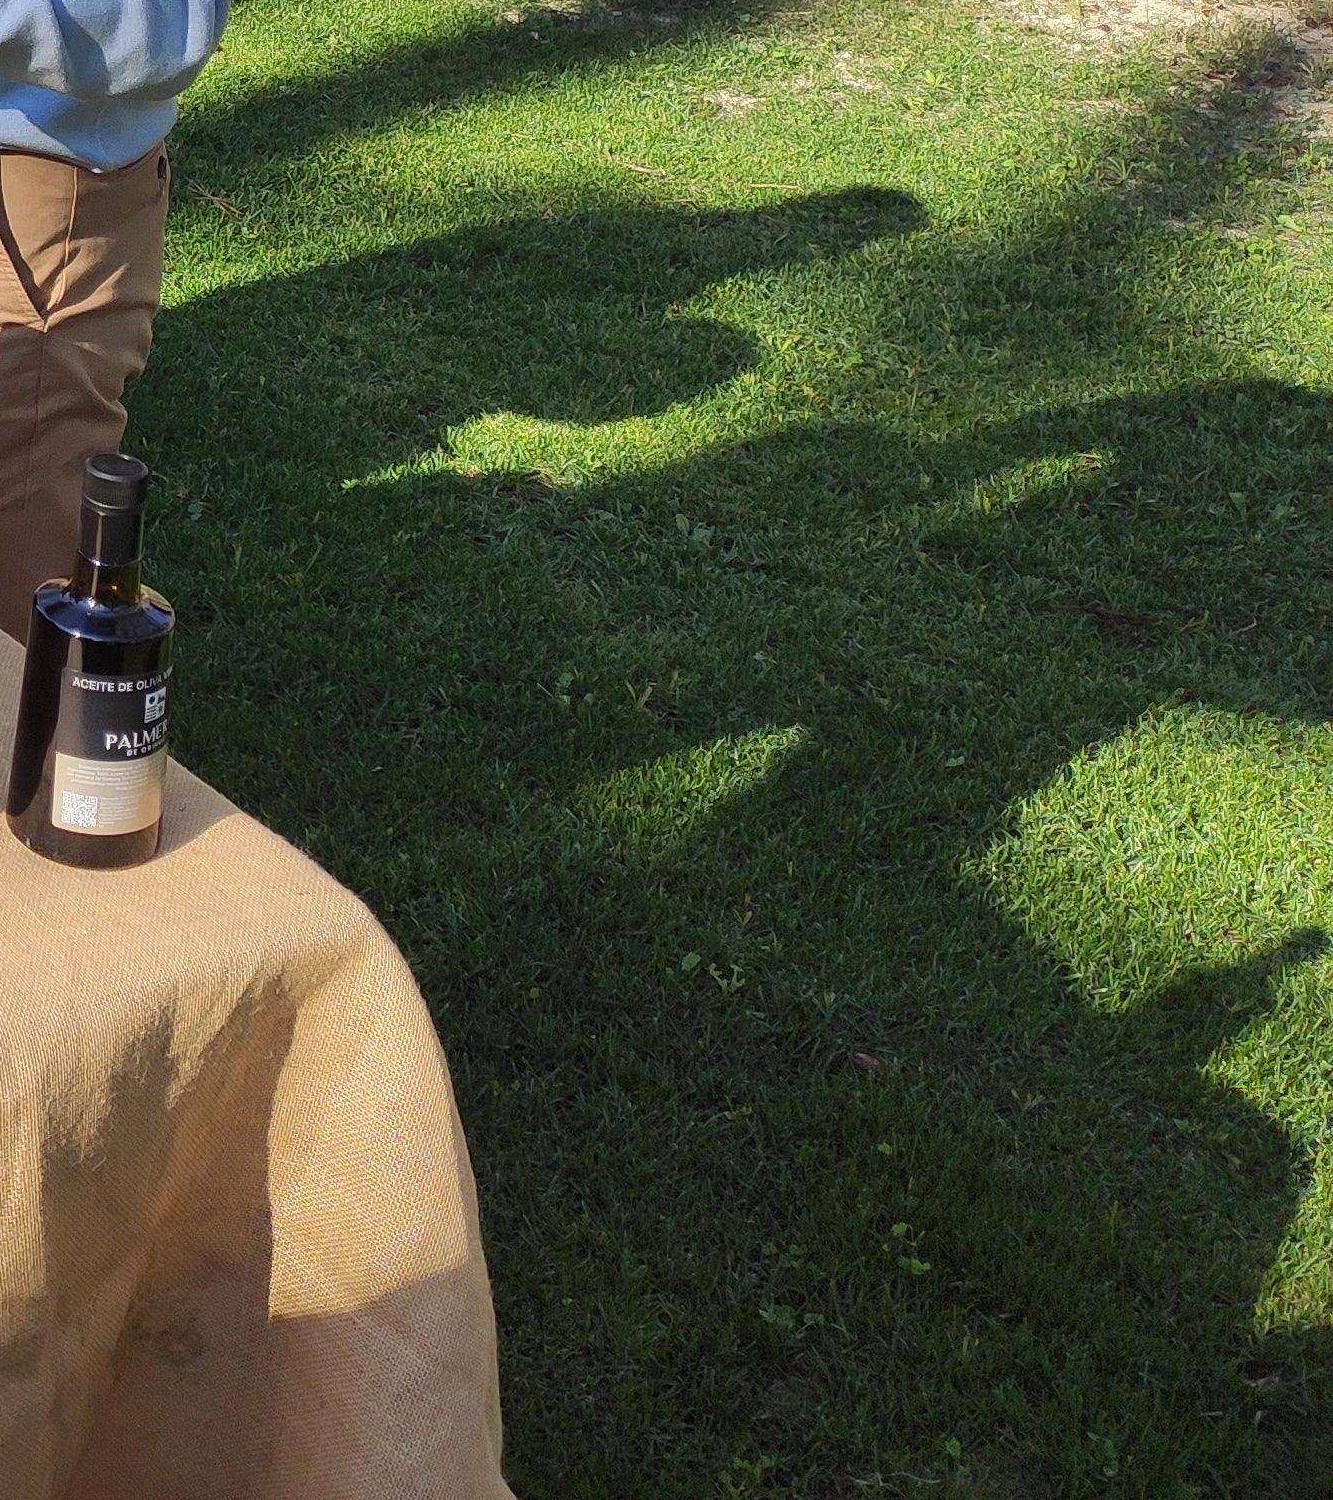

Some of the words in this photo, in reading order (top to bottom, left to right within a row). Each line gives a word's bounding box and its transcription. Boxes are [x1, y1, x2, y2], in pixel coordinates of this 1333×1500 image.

[72, 676, 115, 693] ACEITE
[117, 682, 134, 692] DE
[105, 718, 168, 751] PALMER
